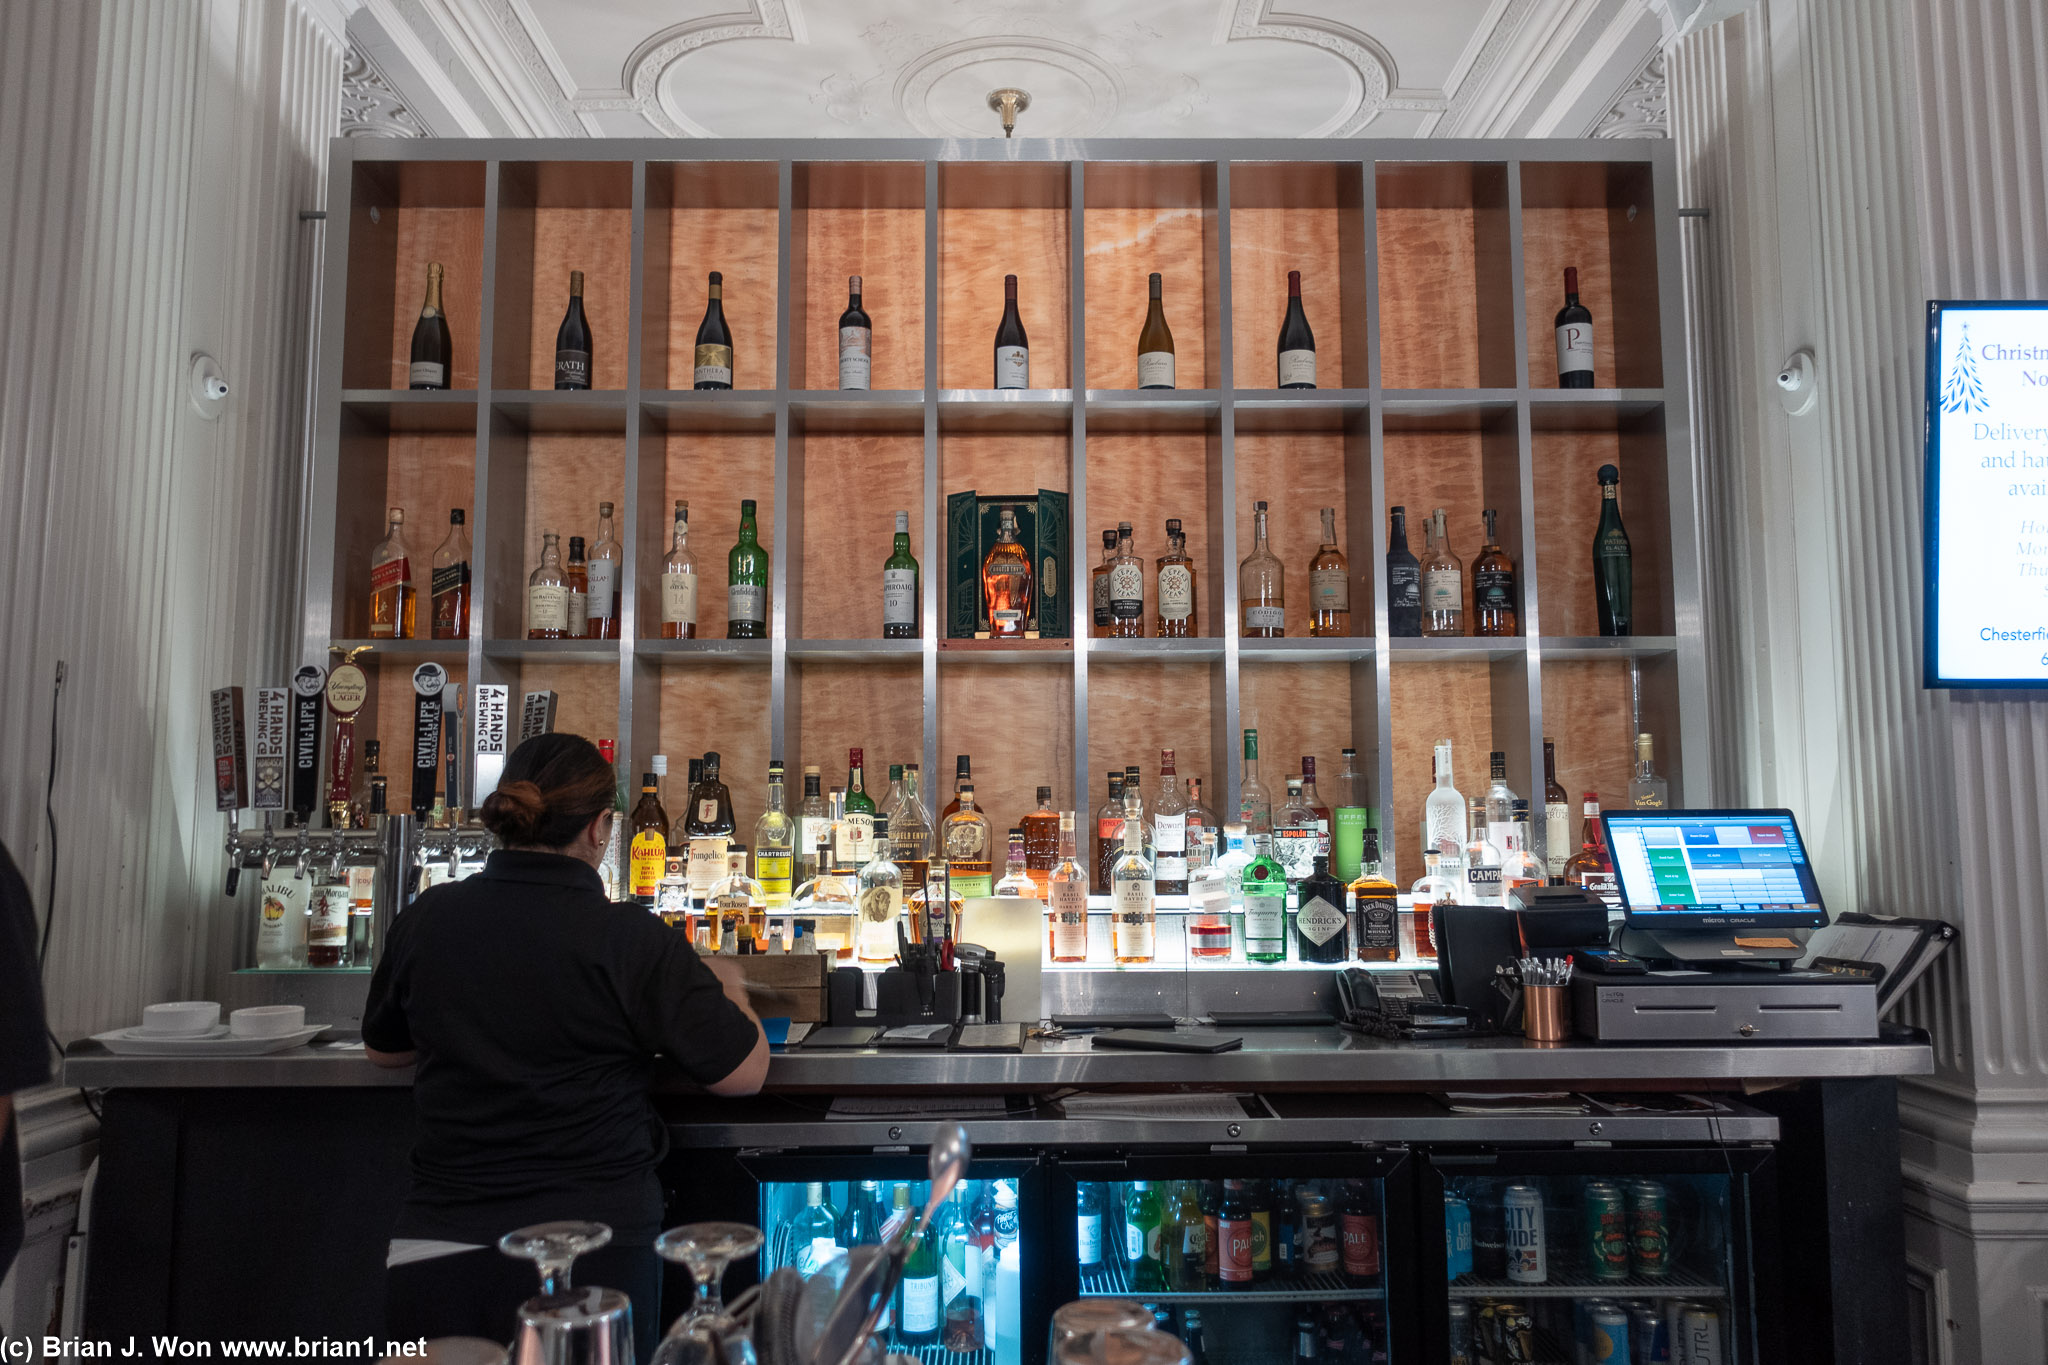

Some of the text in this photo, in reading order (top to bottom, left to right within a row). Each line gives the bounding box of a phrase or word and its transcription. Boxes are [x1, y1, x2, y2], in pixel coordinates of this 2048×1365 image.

[556, 361, 585, 371] RATH
[1981, 450, 2048, 468] and ha
[2021, 520, 2048, 534] Ho
[1114, 569, 1140, 582] KEEPER'S
[1162, 569, 1188, 583] KEEPER'S
[884, 584, 913, 592] PHROAIG
[1116, 588, 1138, 598] HEART
[1164, 588, 1186, 598] HEART
[673, 594, 685, 605] 14
[889, 599, 898, 607] 10
[1980, 627, 2048, 642] Chesterfi
[220, 691, 230, 702] 4
[333, 694, 361, 702] LAGER
[534, 694, 548, 704] 4
[212, 693, 222, 741] BREWING
[257, 690, 269, 739] BREWING
[478, 688, 489, 736] BREWING
[521, 694, 535, 740] BREWING
[269, 691, 285, 755] 4 HANDS
[490, 688, 505, 752] 4 HANDS
[221, 705, 233, 755] HANDS
[430, 723, 439, 767] GOALDEN
[1646, 799, 1663, 807] Gogh
[847, 818, 874, 827] MESO
[1282, 829, 1307, 838] ESPOLÓN
[632, 845, 665, 860] KAHLÚA
[690, 848, 725, 862] Frangelico
[324, 888, 349, 899] Morgan
[719, 901, 748, 909] Four Roses
[1362, 900, 1395, 913] JACK DANIEL'S
[1298, 917, 1342, 925] HENDRICK'S
[1343, 1231, 1368, 1247] PALE
